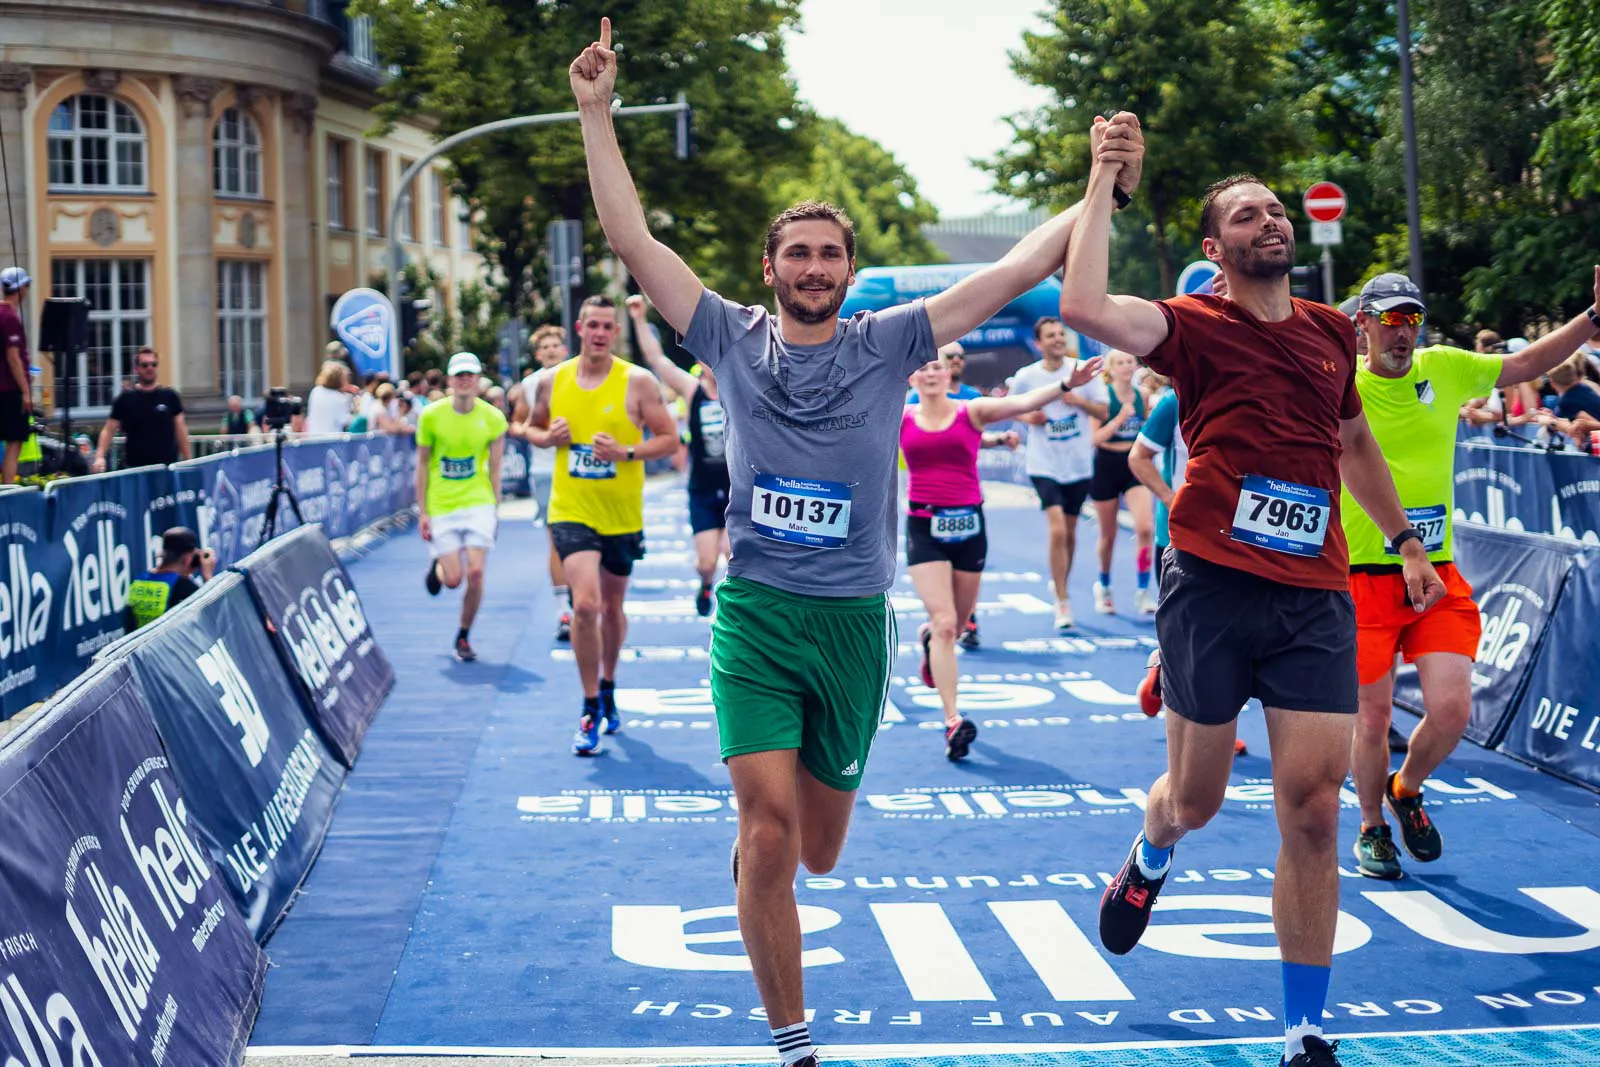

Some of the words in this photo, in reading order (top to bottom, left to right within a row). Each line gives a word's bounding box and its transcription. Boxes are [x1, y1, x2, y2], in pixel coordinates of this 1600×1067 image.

[779, 478, 801, 489] hella
[1270, 480, 1291, 493] hella
[761, 493, 843, 525] 10137
[1249, 493, 1322, 534] 7963
[788, 523, 808, 532] Marc
[1275, 529, 1289, 538] Jan
[1410, 518, 1443, 539] 677
[0, 543, 52, 660] ella
[1531, 697, 1579, 740] DIE
[1581, 716, 1600, 752] L
[516, 796, 739, 819] ella
[866, 788, 1147, 815] hella
[66, 862, 160, 1041] hella
[1474, 985, 1600, 1008] ON
[971, 1011, 1119, 1026] AUF
[1168, 999, 1443, 1023] GRND
